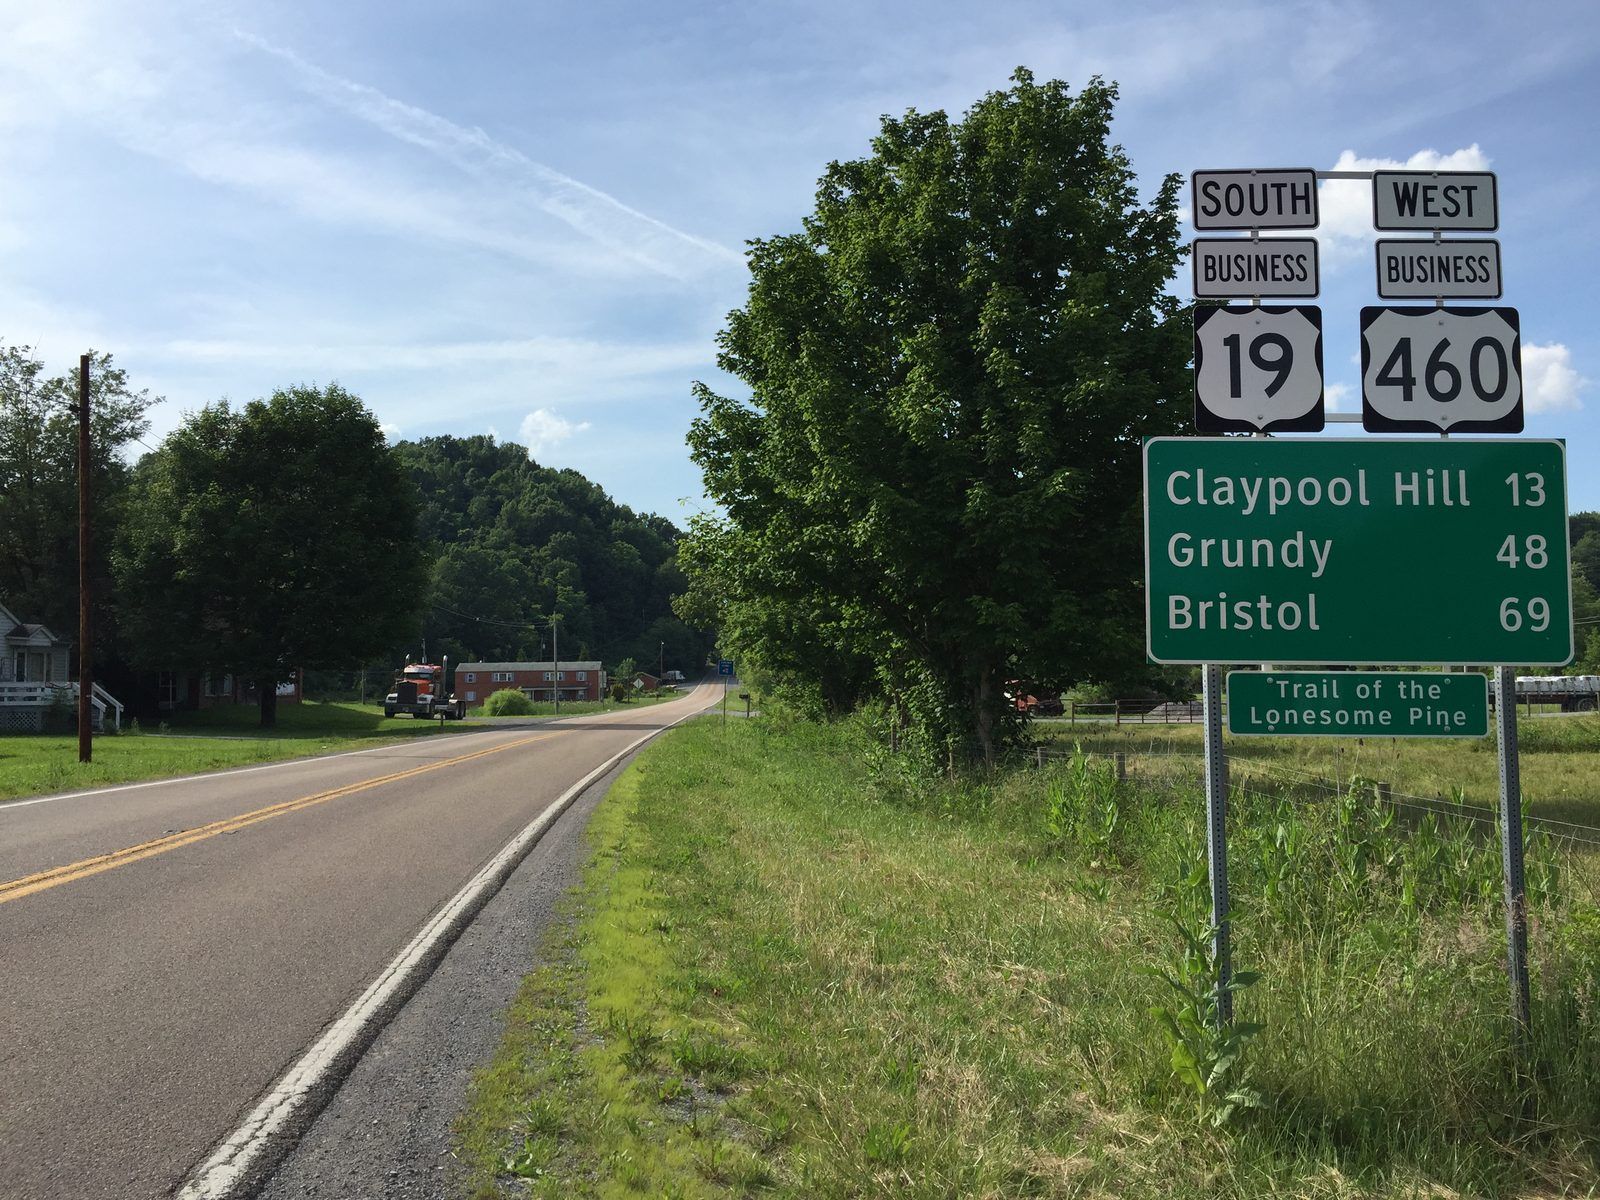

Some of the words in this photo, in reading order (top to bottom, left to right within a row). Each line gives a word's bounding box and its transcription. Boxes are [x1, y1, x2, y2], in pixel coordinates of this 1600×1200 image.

[1201, 180, 1311, 216] SOUTH
[1393, 182, 1477, 217] WEST
[1204, 254, 1308, 283] BUSINESS
[1387, 255, 1491, 283] BUSINESS
[1223, 332, 1294, 398] 19
[1375, 336, 1508, 403] 460
[1166, 468, 1370, 515] Claypool
[1395, 469, 1470, 507] Hill
[1505, 472, 1546, 507] 13
[1168, 531, 1333, 578] Grundy
[1496, 534, 1549, 569] 48
[1168, 592, 1320, 631] Bristol
[1499, 597, 1550, 633] 69
[1276, 679, 1339, 699] Trail
[1356, 679, 1383, 699] of
[1398, 679, 1441, 700] the
[1251, 706, 1392, 726] Lonesome
[1410, 707, 1467, 726] Pine
